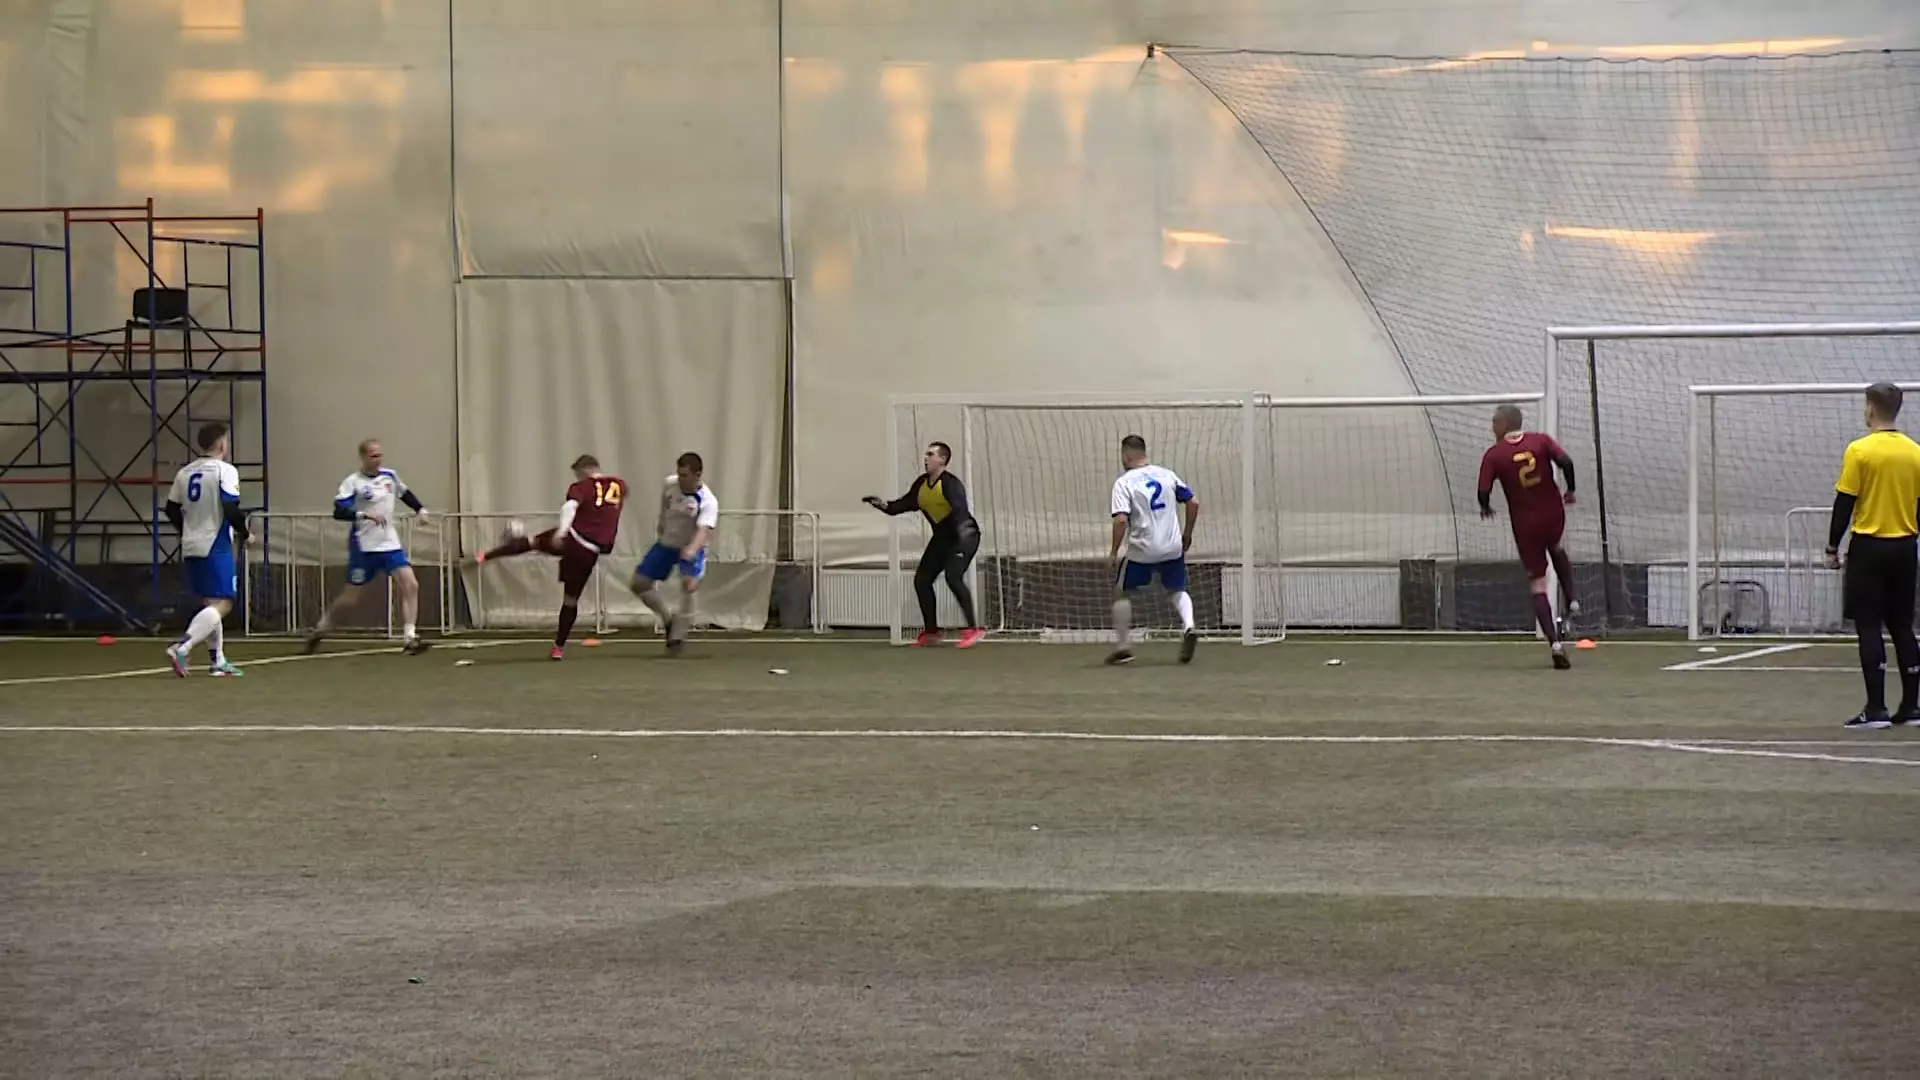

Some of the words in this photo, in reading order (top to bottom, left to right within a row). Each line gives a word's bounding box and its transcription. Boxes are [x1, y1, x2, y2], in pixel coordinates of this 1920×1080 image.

[1513, 451, 1541, 488] 2
[187, 473, 202, 502] 6
[595, 480, 621, 507] 14
[1145, 480, 1166, 511] 2
